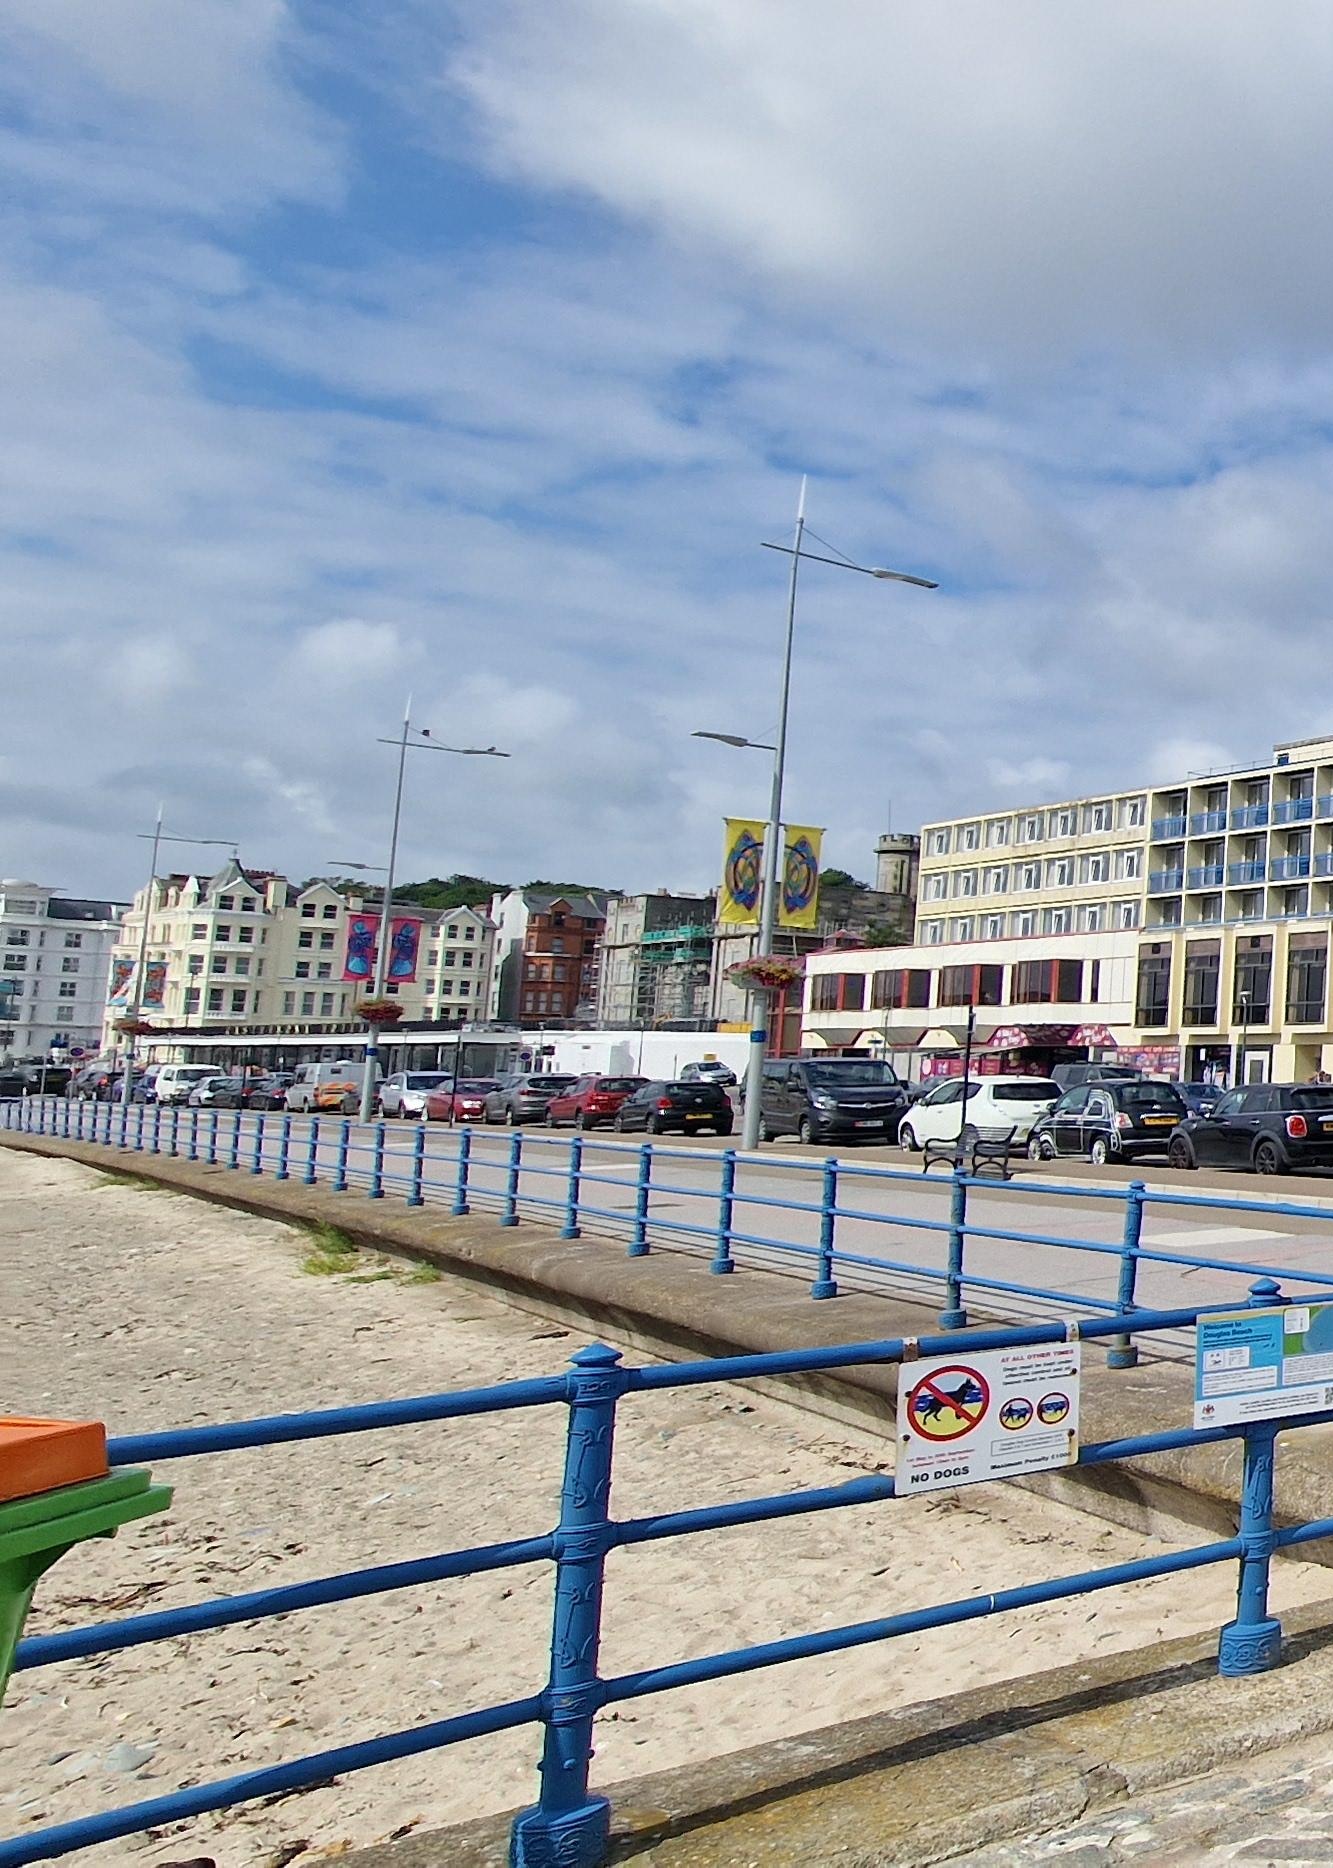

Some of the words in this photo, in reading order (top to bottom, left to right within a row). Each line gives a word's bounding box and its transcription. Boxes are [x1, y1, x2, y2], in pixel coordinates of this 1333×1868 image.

[1203, 1330, 1231, 1339] Douglas
[1232, 1328, 1253, 1336] Beach
[1027, 1352, 1051, 1360] OTHER
[1024, 1456, 1050, 1465] Penalty
[911, 1472, 930, 1484] NO
[934, 1466, 970, 1480] DOGS
